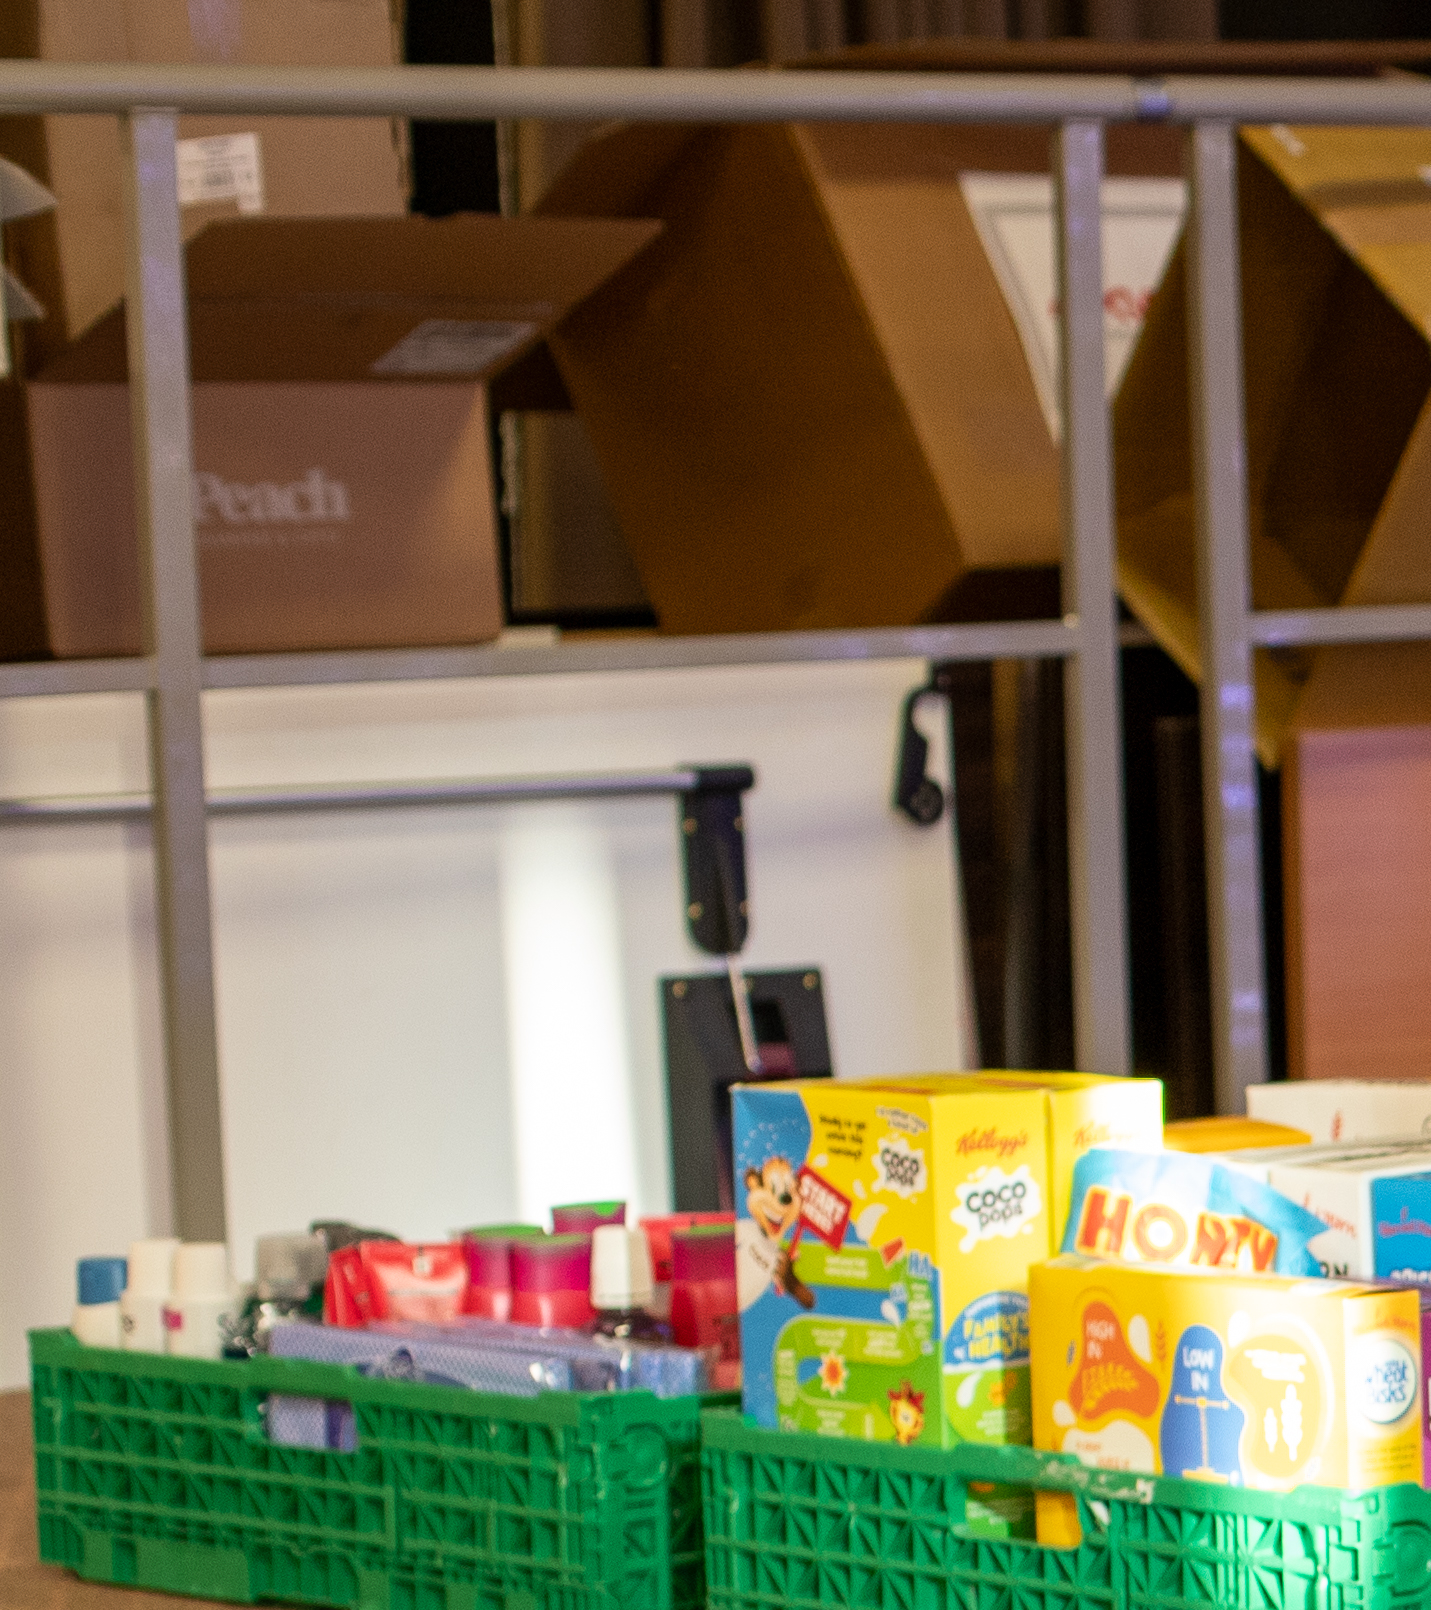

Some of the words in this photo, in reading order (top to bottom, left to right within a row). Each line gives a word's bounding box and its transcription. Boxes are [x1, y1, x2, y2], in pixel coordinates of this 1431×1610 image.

[956, 1125, 1029, 1157] Kellogg's
[1182, 1345, 1215, 1371] LOW
[1190, 1370, 1211, 1393] IN
